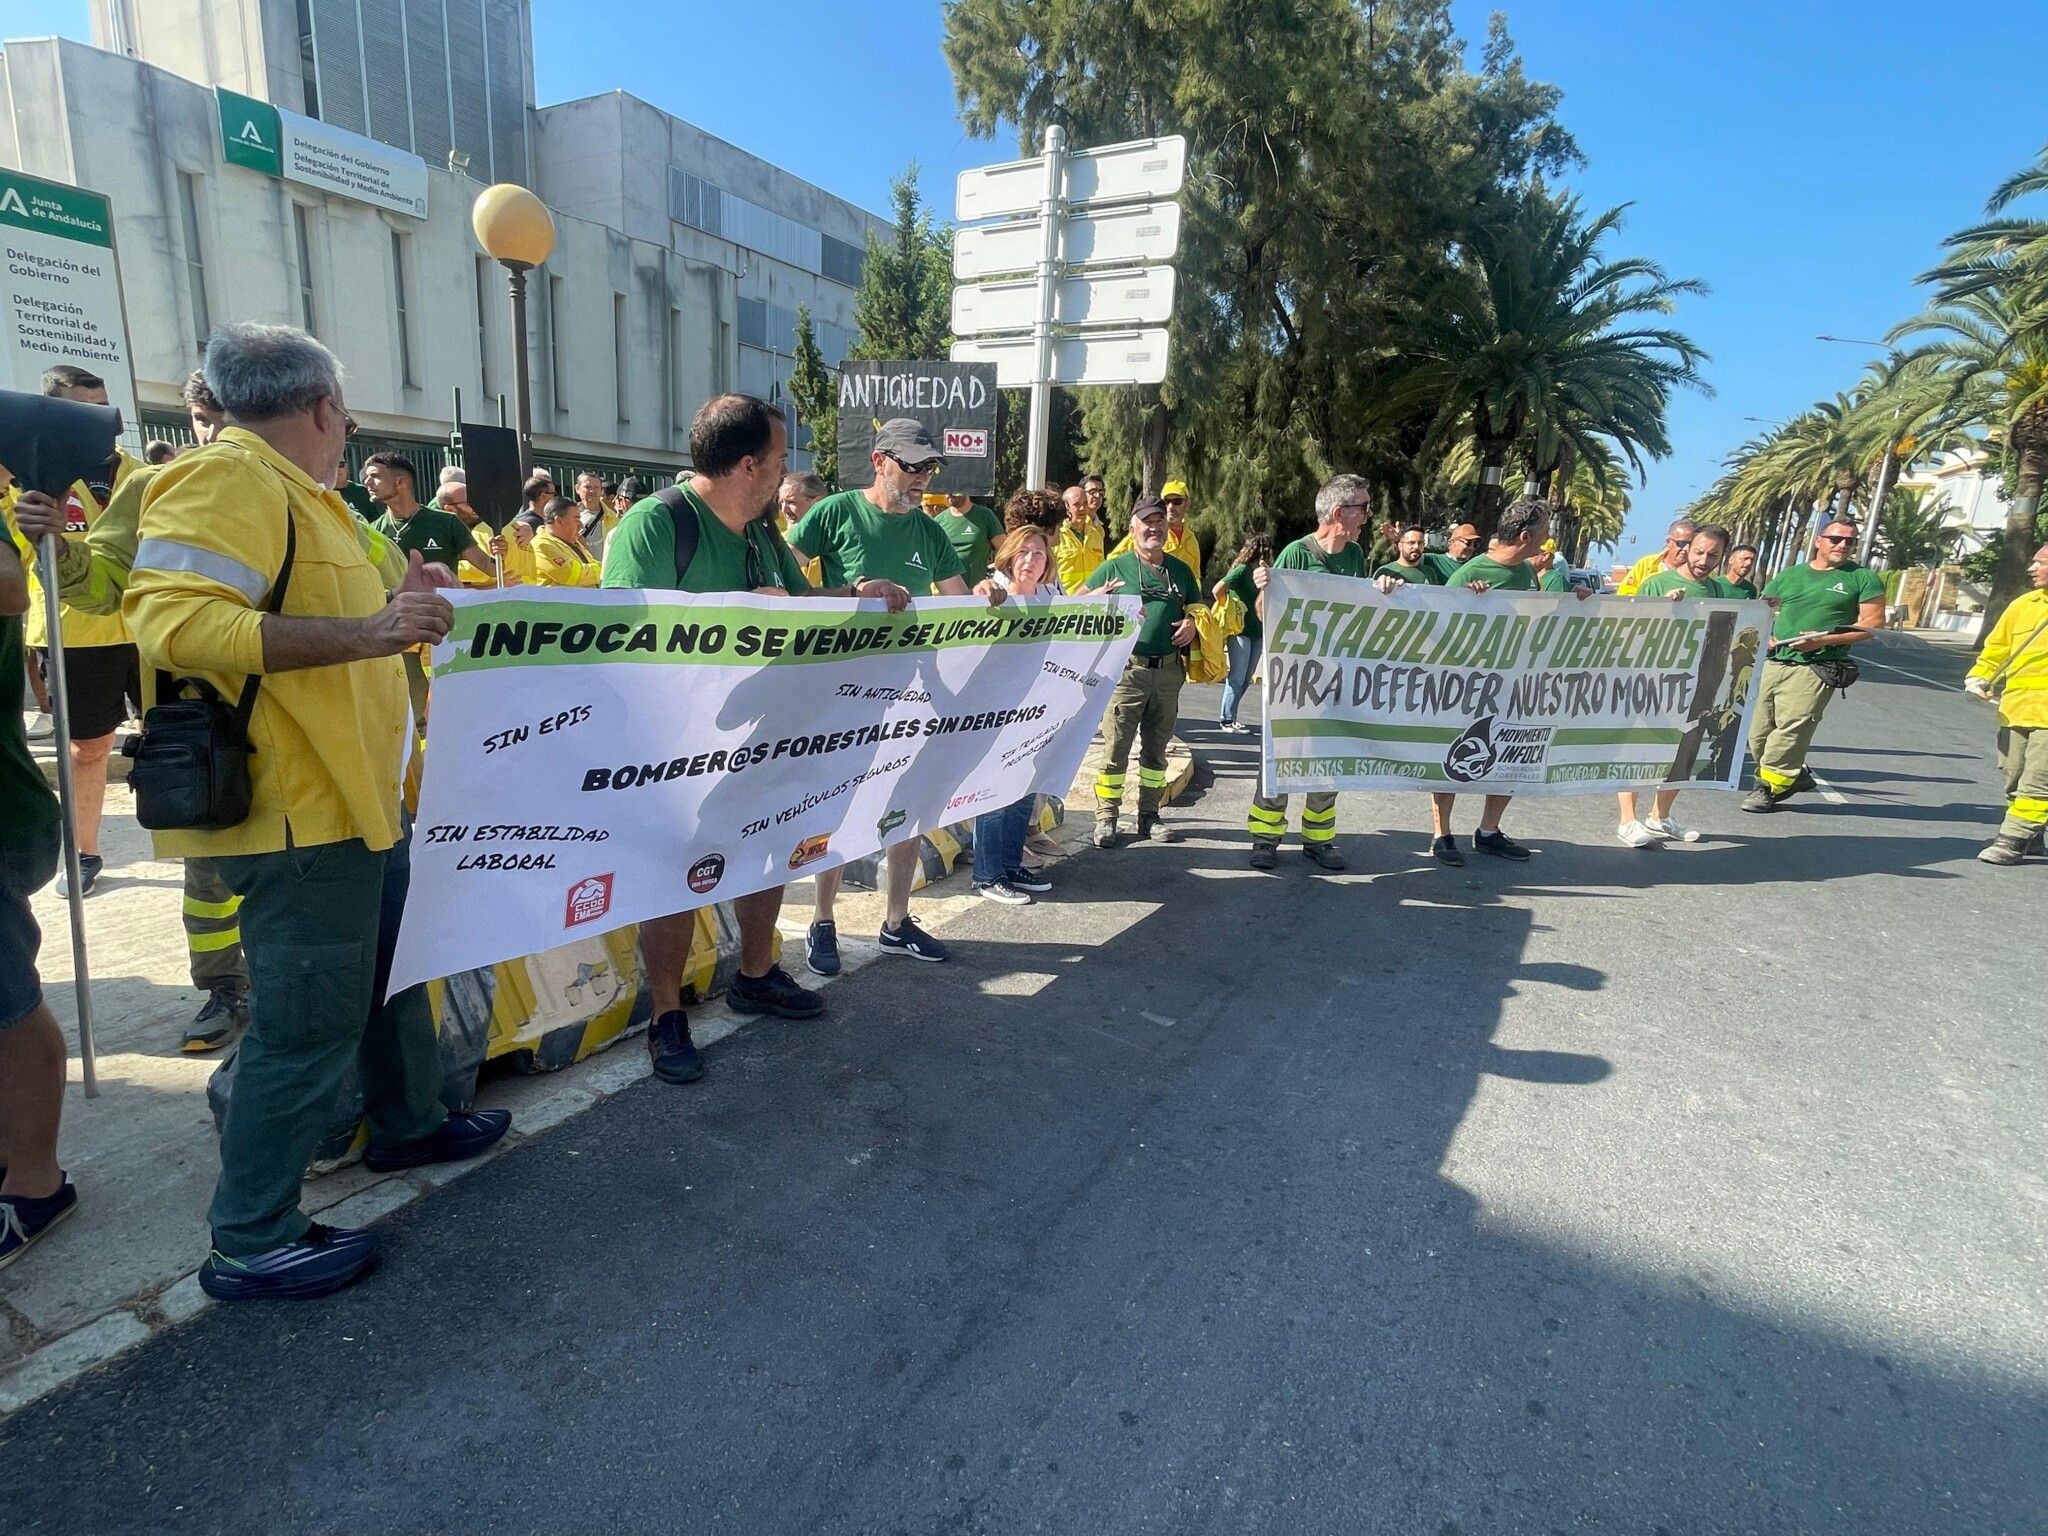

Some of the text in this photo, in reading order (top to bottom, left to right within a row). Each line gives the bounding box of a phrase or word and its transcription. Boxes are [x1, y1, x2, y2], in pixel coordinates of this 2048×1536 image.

[294, 138, 339, 159] Delegación
[341, 153, 353, 165] del
[355, 159, 390, 176] Gobierno
[294, 152, 391, 189] Delegación Territorial de
[294, 163, 413, 206] Sostenibilidad y Medio Ambiente
[31, 196, 62, 212] Junta
[32, 207, 46, 218] de
[6, 248, 101, 277] Delegación del
[9, 264, 70, 285] Gobierno
[13, 294, 83, 316] Delegación
[15, 309, 98, 332] Territorial de
[18, 324, 116, 350] Sostenibilidad y
[20, 339, 120, 363] Medio Ambiente
[840, 373, 986, 410] ANTIGÜEDAD
[65, 521, 86, 531] GT
[470, 614, 1125, 658] INFOCA NO SE VENDE, SE LUCHA Y SE DEFIENDE
[1269, 597, 1706, 669] ESTABILIDAD Y DERECHOS
[1043, 661, 1060, 674] SIN
[835, 684, 862, 698] SIN
[1268, 656, 1695, 721] PARA DEFENDER NUESTRO MONTE
[483, 705, 592, 754] SIN EPIS
[1494, 728, 1551, 743] MOVIMIENTO
[580, 704, 1047, 792] BOMBER@S FORESTALES SIN DERECHOS
[1498, 744, 1545, 764] INFOCA
[1276, 760, 1302, 778] ASES
[1305, 759, 1344, 777] JUSTAS
[1355, 759, 1427, 778] ESTABILIDAD
[740, 818, 770, 840] SIN
[775, 780, 849, 825] VEHÍCULOS
[852, 755, 912, 788] SEGUROS
[425, 825, 610, 843] SIN ESTABILIDAD
[456, 853, 556, 871] LABORAL
[697, 865, 717, 877] CGT
[576, 898, 604, 912] CCOO
